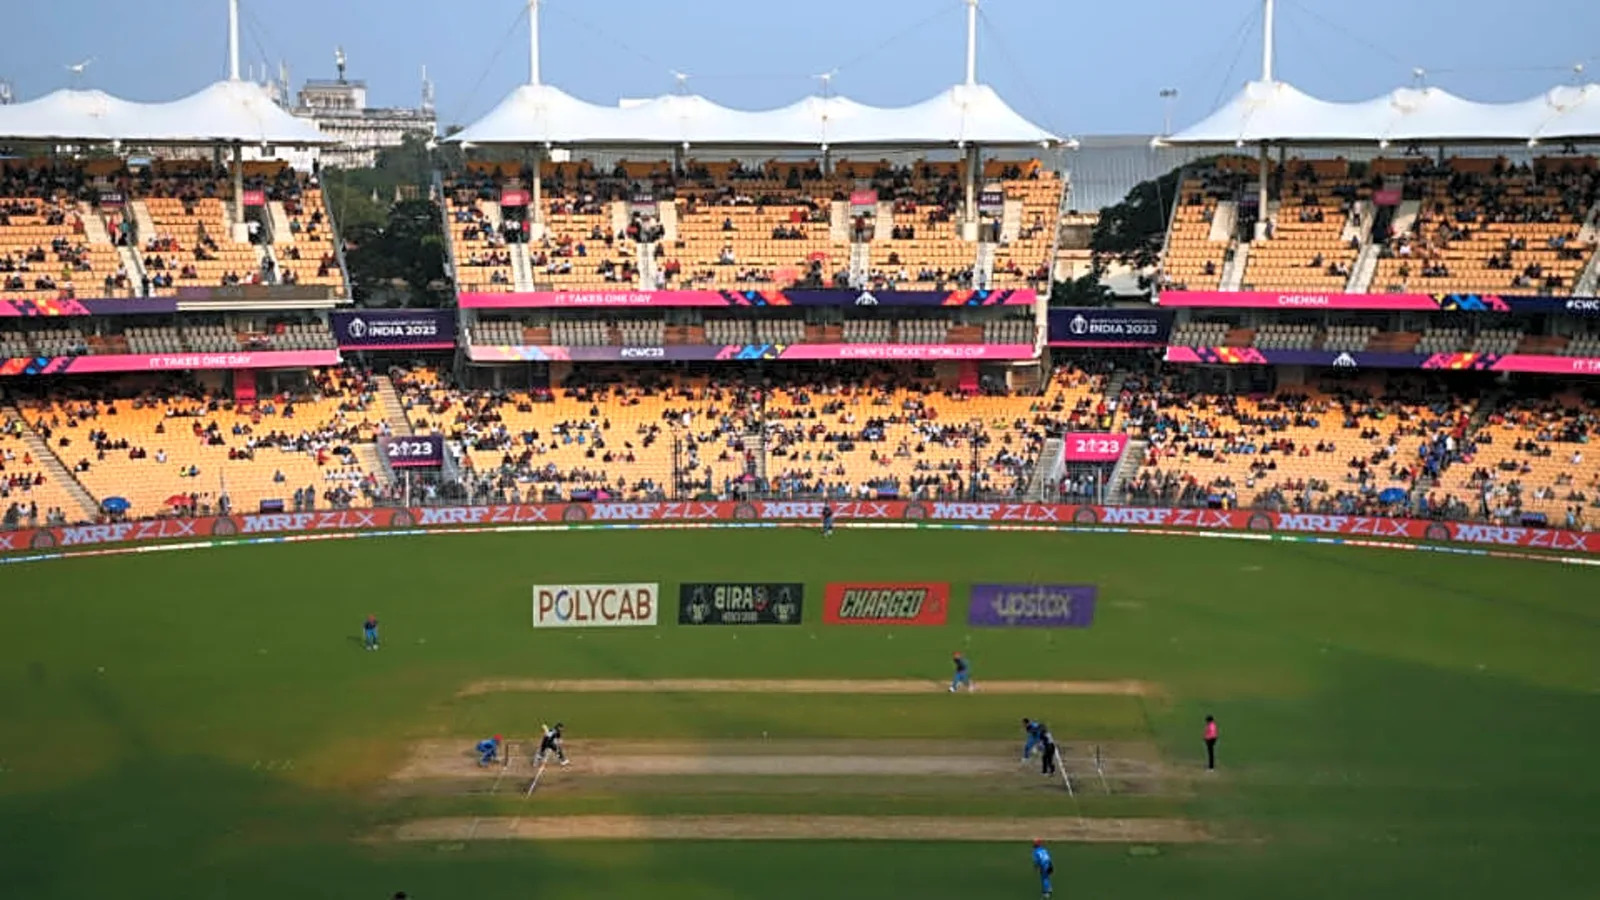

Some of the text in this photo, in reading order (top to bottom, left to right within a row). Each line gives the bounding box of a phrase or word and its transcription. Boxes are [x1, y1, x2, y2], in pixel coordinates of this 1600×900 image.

[1279, 295, 1329, 306] CHENNAI
[369, 325, 437, 337] INDIA 2023
[1090, 324, 1157, 335] INDIA 2023
[203, 355, 226, 365] ONE
[420, 505, 548, 525] MRF ZLX
[591, 502, 719, 519] MRF ZLX
[761, 502, 889, 519] MRF ZLX
[932, 502, 1059, 521] MRF ZLX
[1103, 507, 1233, 528] MRF ZLX
[242, 510, 376, 533] MRF ZLX
[1277, 513, 1410, 537] MRF ZLX
[61, 519, 197, 546] MRF ZLX
[1455, 523, 1588, 550] MRF ZLX
[538, 589, 651, 621] POLYCAB
[840, 588, 927, 619] CHARGED
[992, 588, 1071, 624] upstox
